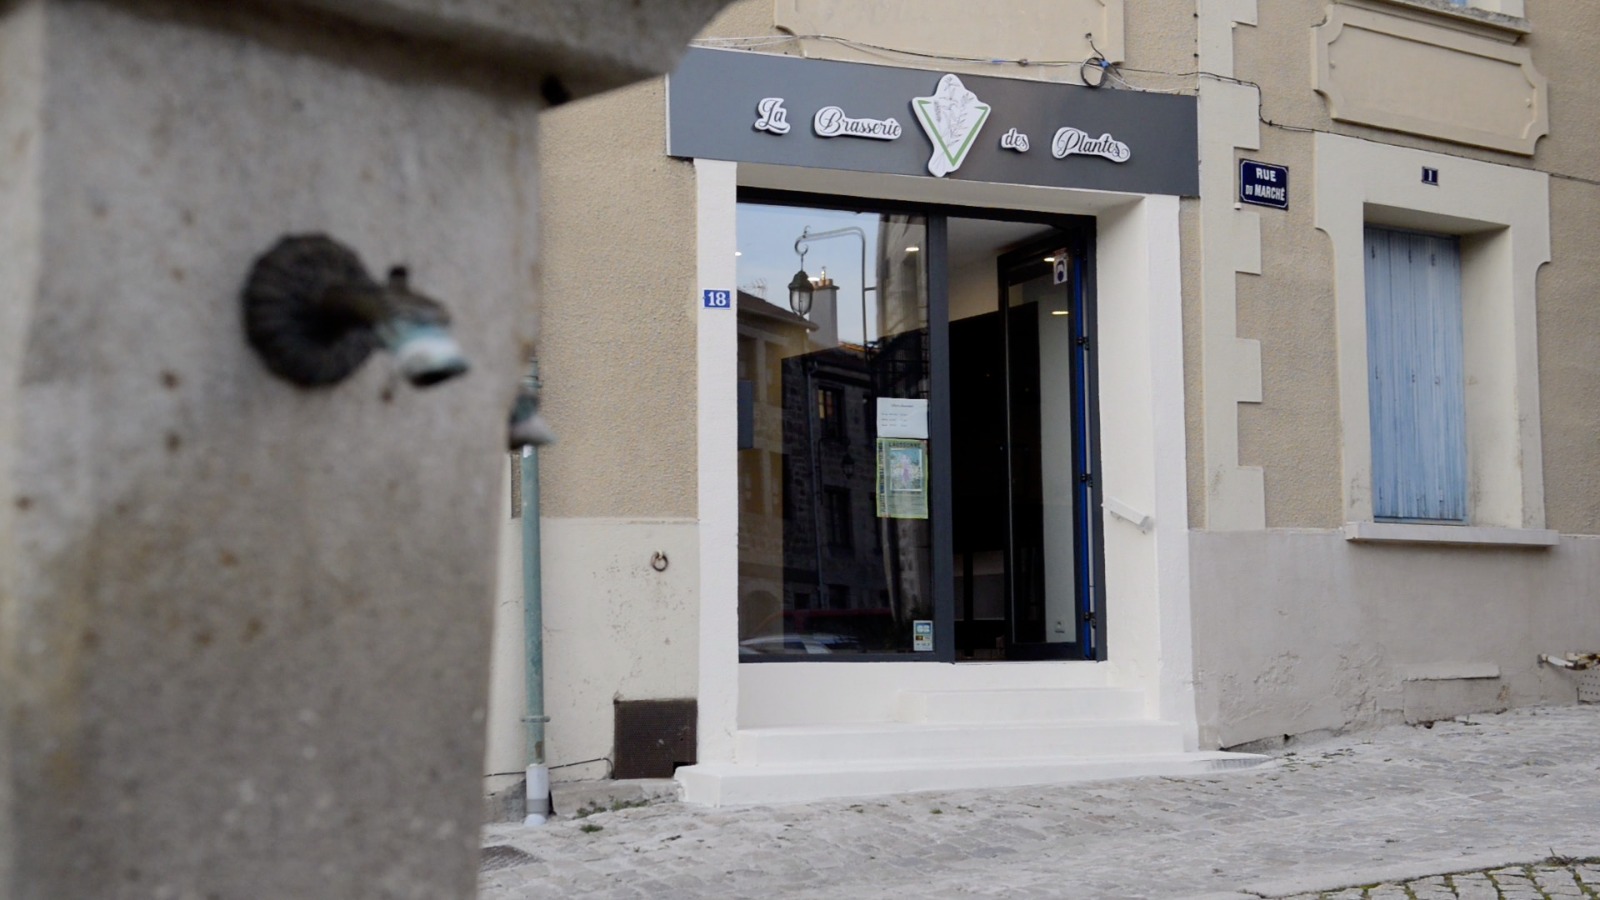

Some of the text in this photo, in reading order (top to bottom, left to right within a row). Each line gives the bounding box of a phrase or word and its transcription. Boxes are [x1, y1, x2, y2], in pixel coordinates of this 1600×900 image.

[757, 98, 1129, 160] La Brasserie des Plantes
[1256, 168, 1276, 182] RUE
[1245, 184, 1285, 201] DU MARCHÉ
[708, 291, 726, 306] 18
